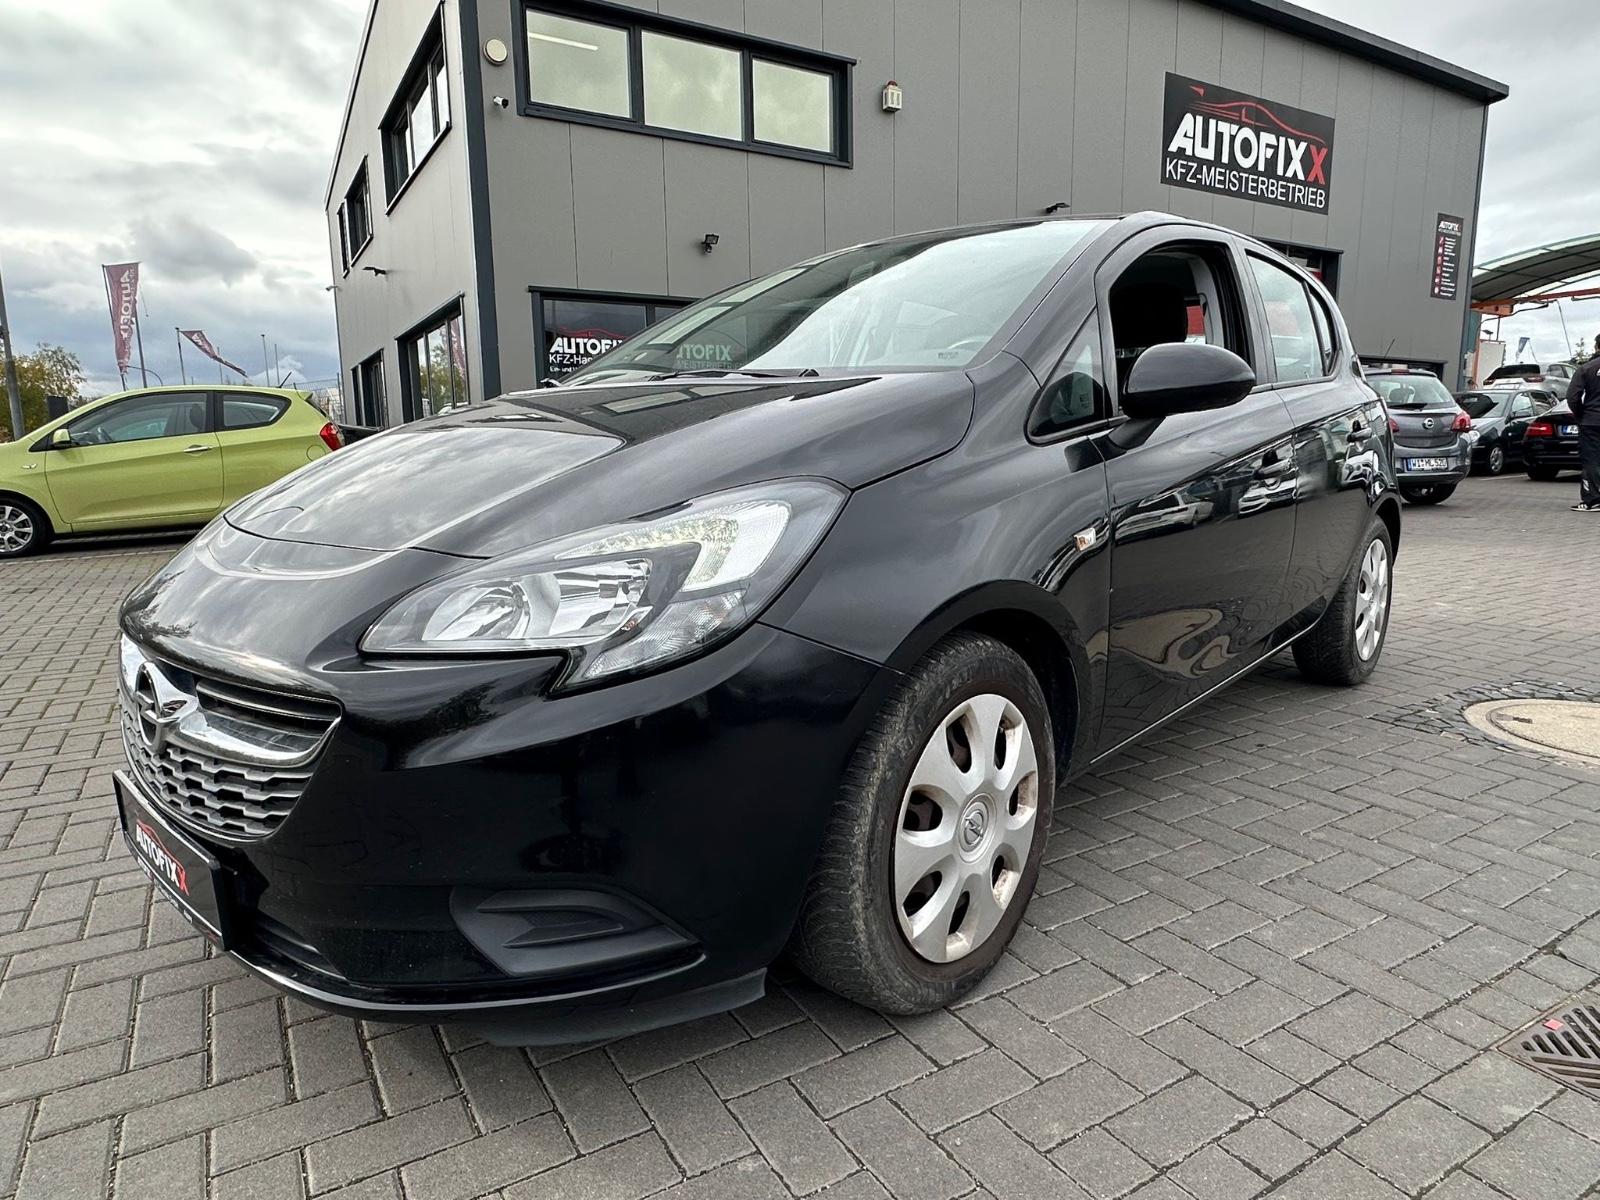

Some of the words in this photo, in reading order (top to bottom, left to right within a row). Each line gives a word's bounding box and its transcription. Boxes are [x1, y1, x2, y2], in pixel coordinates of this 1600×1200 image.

[1167, 112, 1328, 185] AUTOFIXX
[1165, 157, 1326, 209] KFZ-MEISTERBETRIEB
[549, 337, 623, 355] AUTOF
[136, 824, 190, 896] AUTOFIXX
